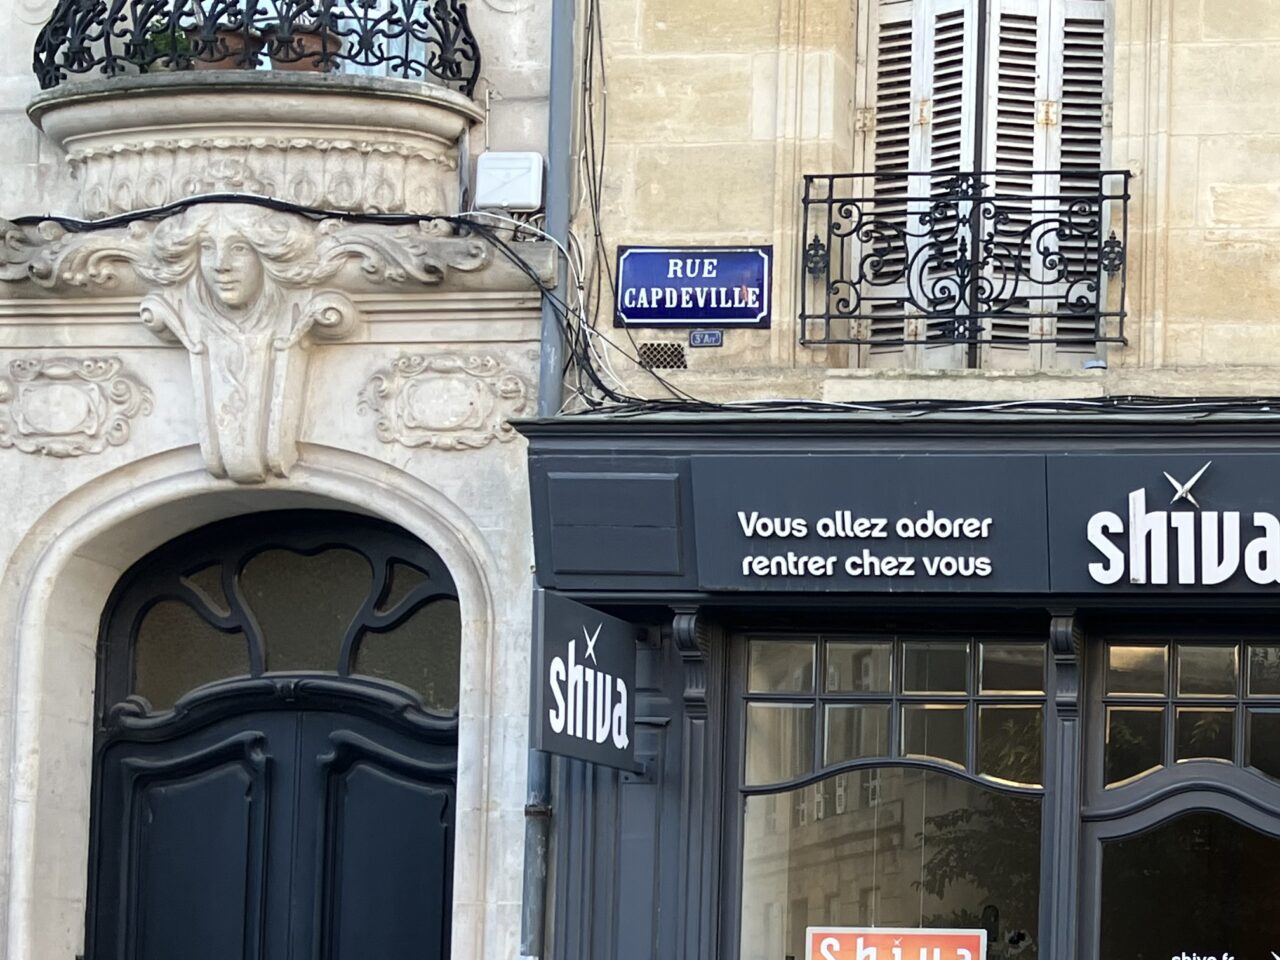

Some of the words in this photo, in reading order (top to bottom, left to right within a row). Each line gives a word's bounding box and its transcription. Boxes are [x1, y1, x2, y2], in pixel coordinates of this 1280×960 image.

[667, 258, 718, 278] RUE
[623, 287, 760, 308] CAPDEVILLE
[737, 511, 808, 538] Vous
[816, 510, 888, 538] allez
[896, 510, 993, 538] adorer
[742, 551, 838, 576] rentrer
[845, 549, 916, 576] chez
[922, 556, 993, 577] vous
[549, 622, 630, 750] shiva
